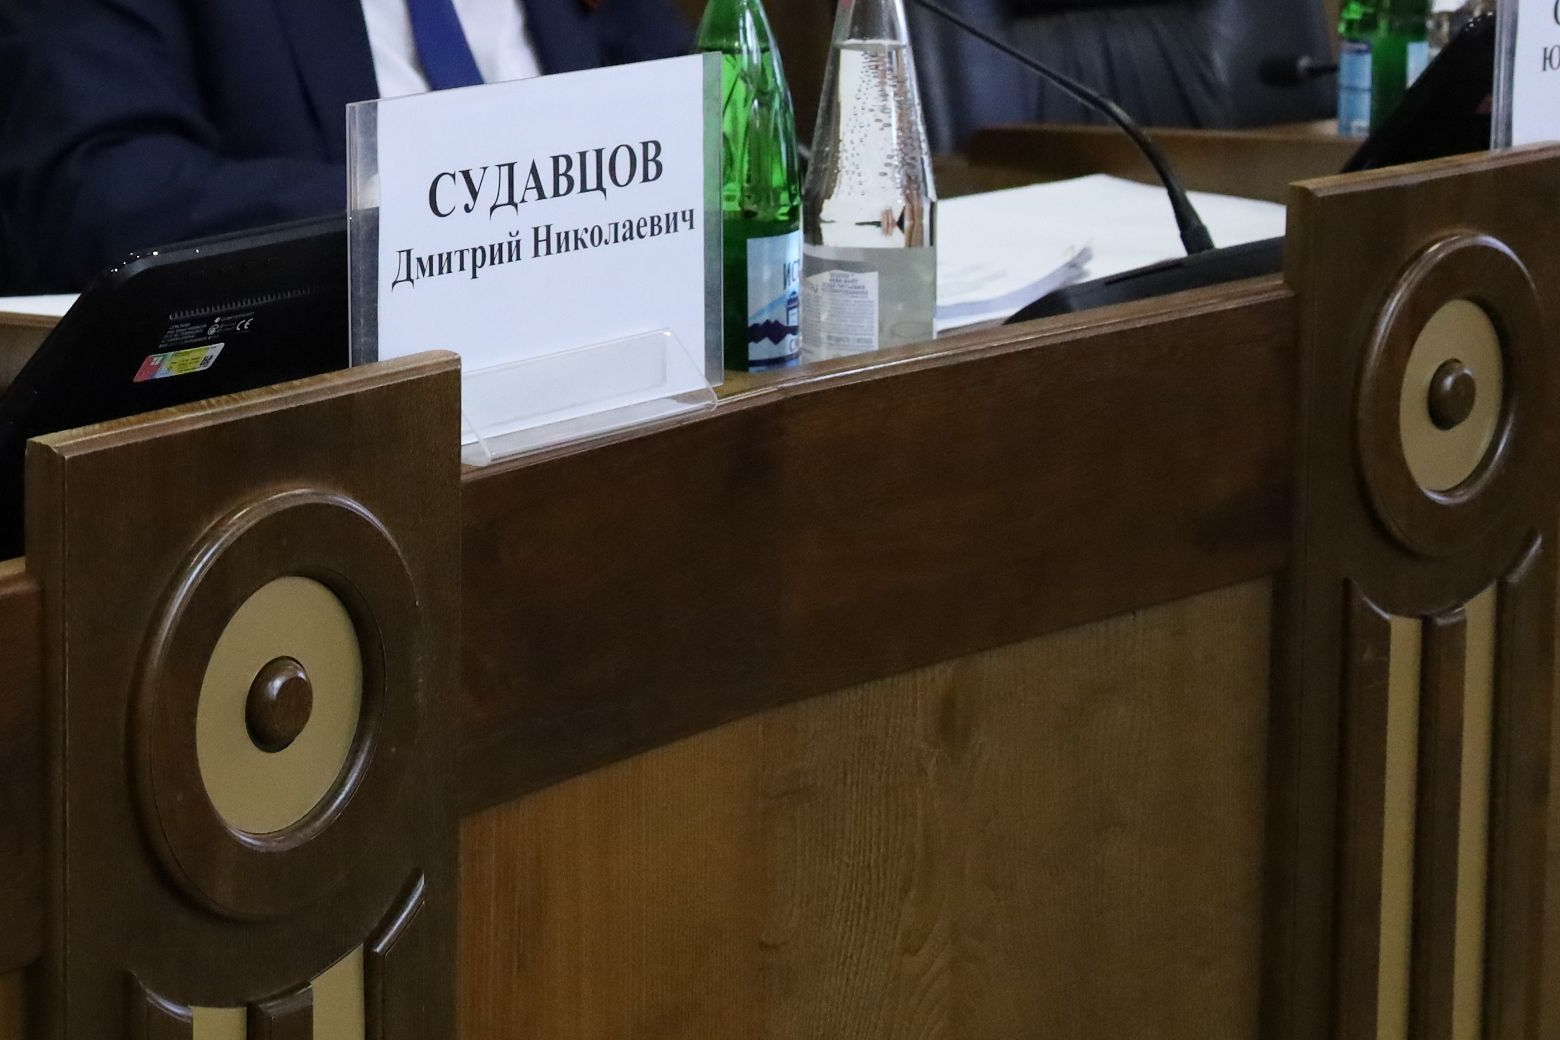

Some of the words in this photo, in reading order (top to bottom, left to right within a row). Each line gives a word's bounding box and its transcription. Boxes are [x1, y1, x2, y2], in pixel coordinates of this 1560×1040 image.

[427, 139, 664, 220] СУДАВЦОВ
[390, 229, 523, 292] Дмитрий
[531, 207, 696, 260] Николаевич
